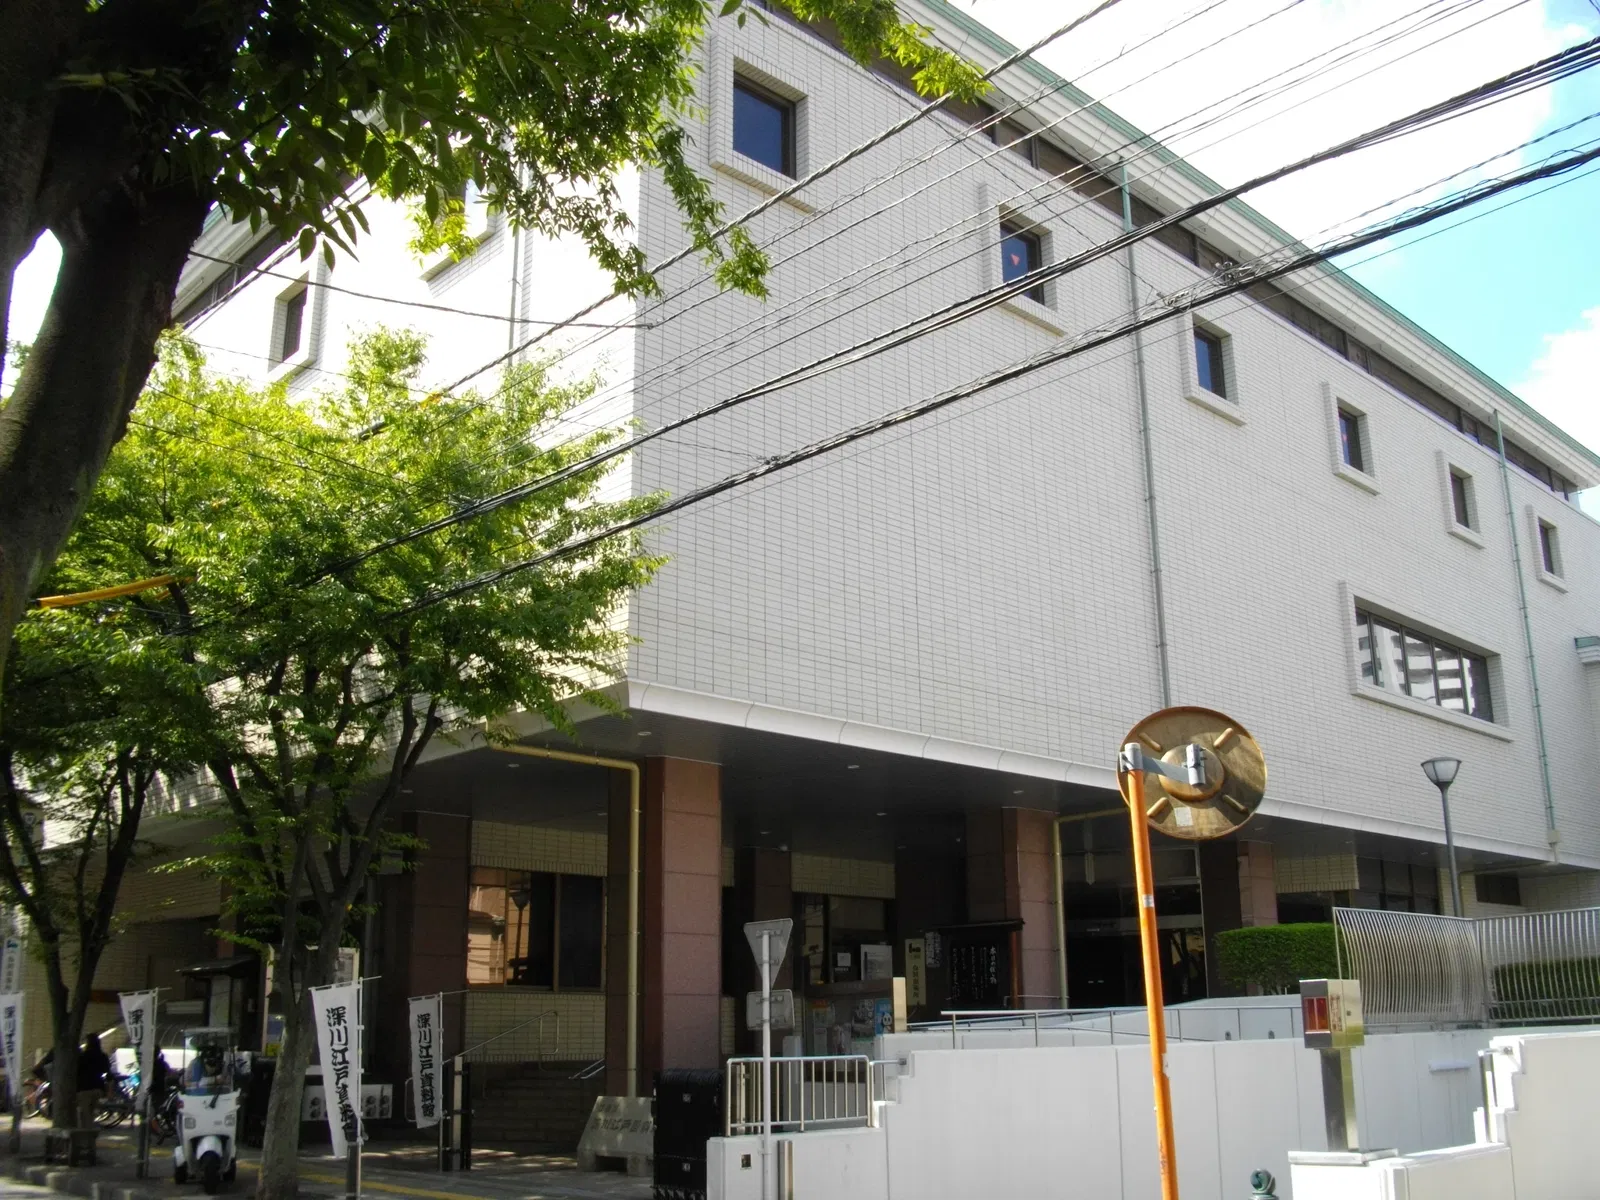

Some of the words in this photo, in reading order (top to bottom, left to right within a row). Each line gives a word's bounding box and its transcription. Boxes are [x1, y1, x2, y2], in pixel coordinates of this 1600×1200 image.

[416, 1012, 436, 1118] 深川江戸資料館
